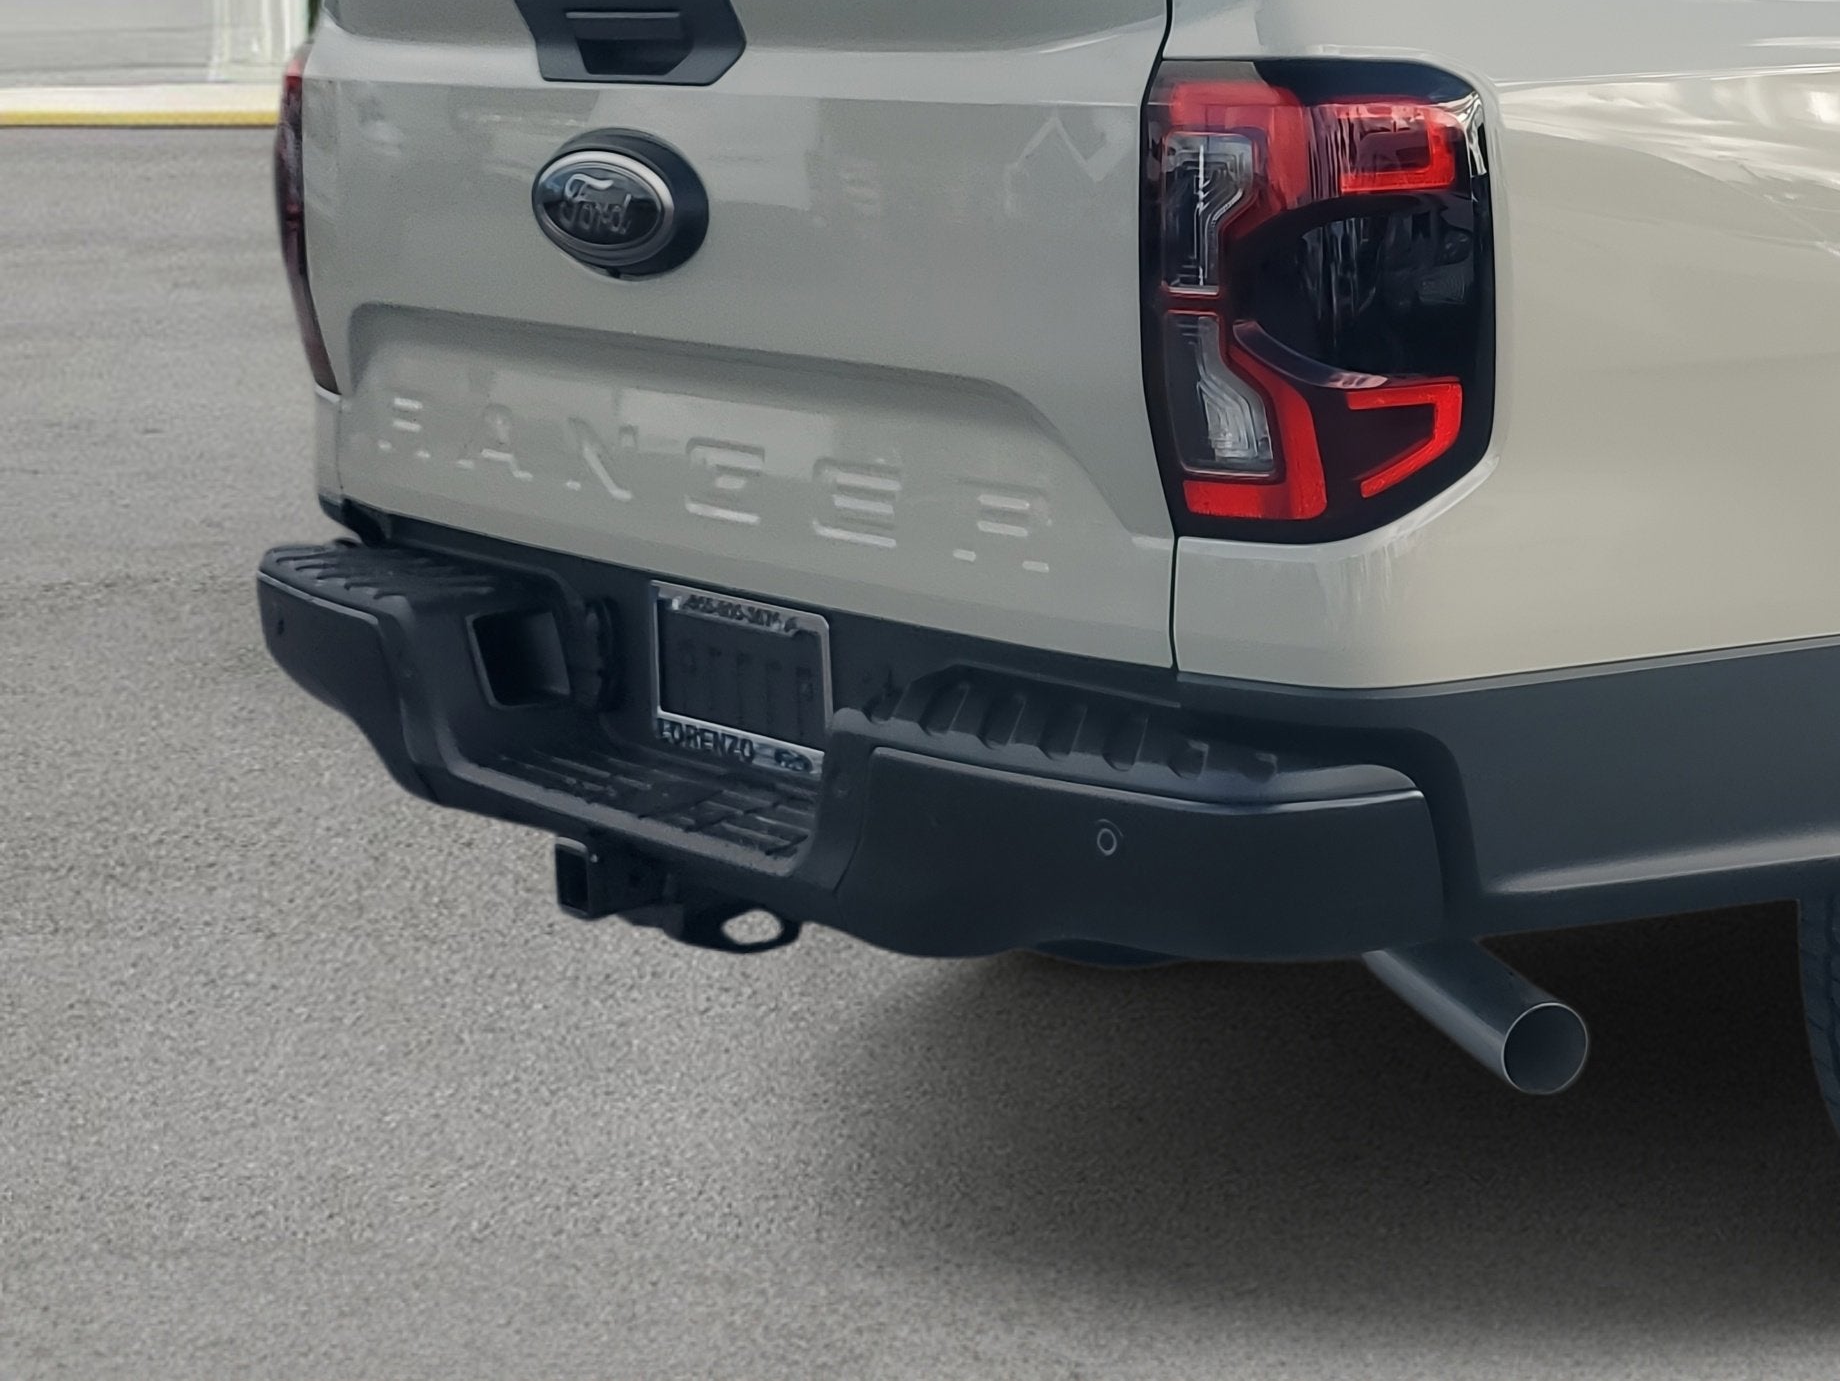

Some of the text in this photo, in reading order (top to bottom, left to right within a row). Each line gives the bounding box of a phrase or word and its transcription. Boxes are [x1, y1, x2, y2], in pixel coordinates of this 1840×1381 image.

[559, 173, 633, 236] Ford
[376, 388, 1052, 573] RANGER
[657, 717, 756, 763] LORENZO
